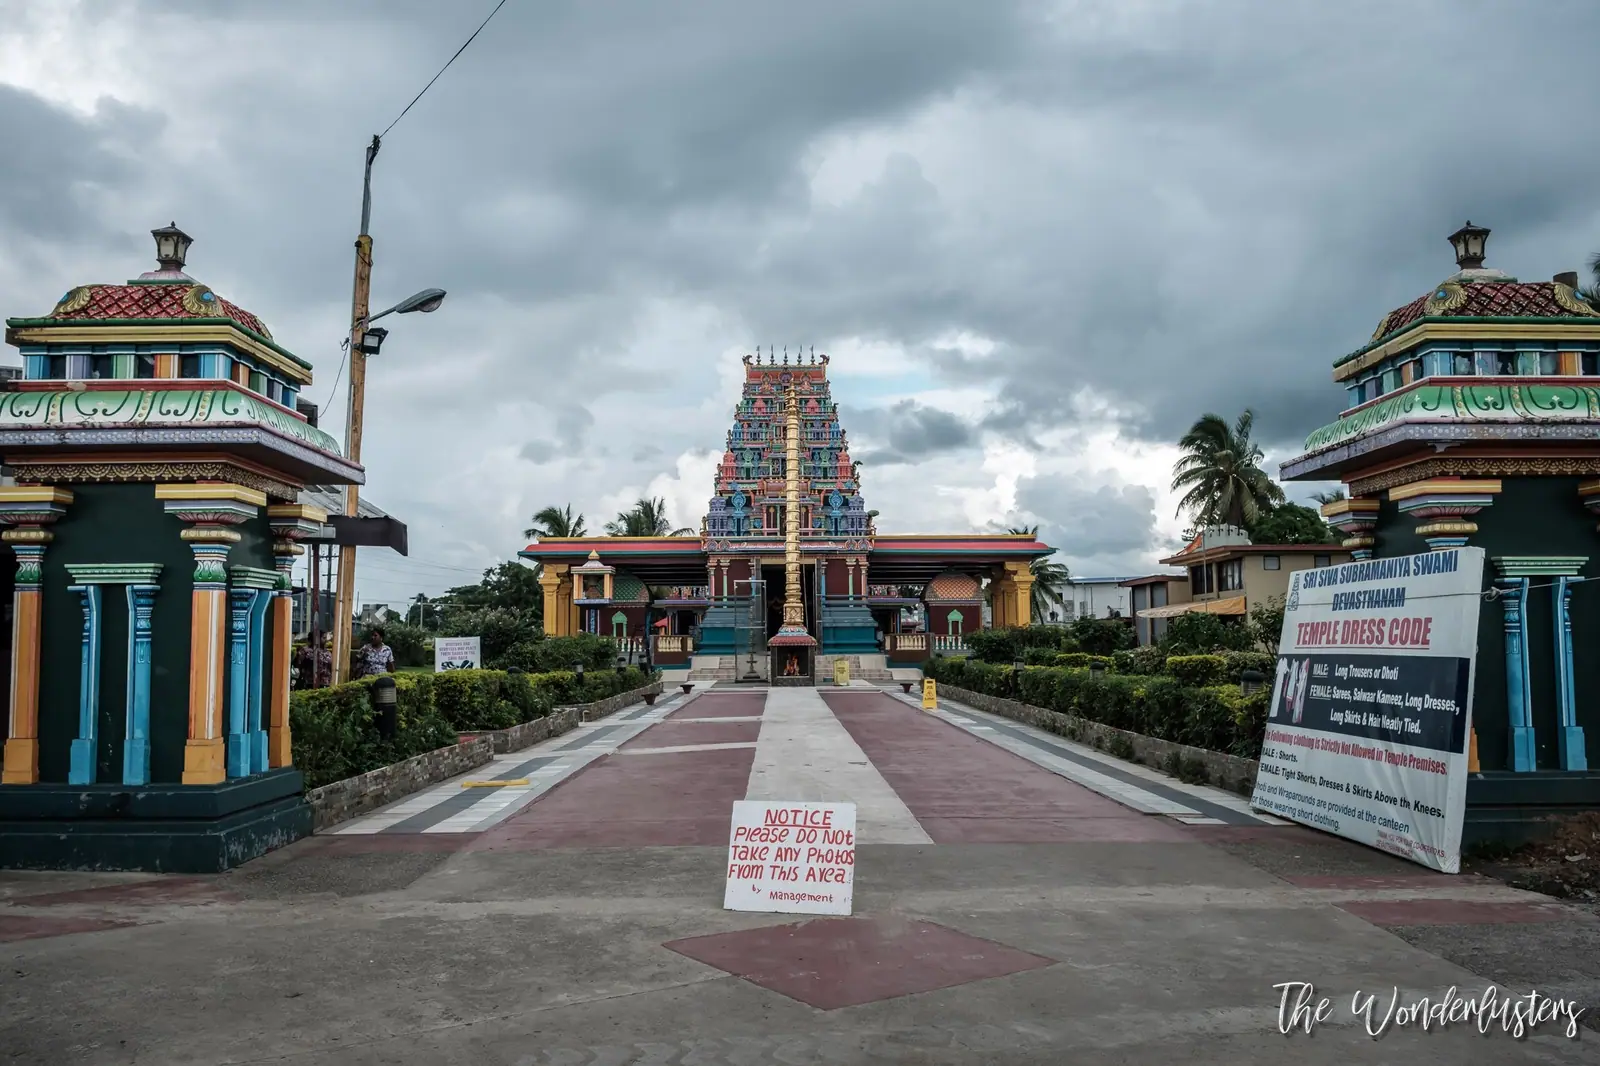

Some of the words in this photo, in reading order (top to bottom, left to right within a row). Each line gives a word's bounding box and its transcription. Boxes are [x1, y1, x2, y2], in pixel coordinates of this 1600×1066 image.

[1303, 571, 1318, 589] SRI
[1318, 567, 1339, 587] SIVA
[1340, 557, 1411, 584] SUBRAMANIYA
[1413, 550, 1459, 576] SWAMI
[1332, 587, 1406, 611] DEVASTHANAM
[1297, 620, 1340, 645] TEMPLE
[1340, 618, 1387, 645] DRESS
[1388, 617, 1433, 646] CODE
[1335, 664, 1348, 680] Long
[1349, 664, 1373, 679] Trousers
[1374, 668, 1381, 679] or
[1381, 666, 1399, 680] Dhoti
[1309, 684, 1333, 699] FEMALE:
[1332, 686, 1352, 703] Sarees,
[1353, 688, 1376, 703] Salwaar
[1376, 690, 1404, 708] Kameez,
[1405, 692, 1422, 711] Long
[1424, 694, 1460, 715] Dresses,
[1330, 708, 1344, 725] Long
[1344, 710, 1361, 725] Skirts
[1362, 712, 1367, 726] &
[1368, 713, 1381, 728] Hair
[1381, 715, 1403, 735] Neatly
[1404, 717, 1421, 734] Tied.
[1320, 737, 1341, 755] Strictly
[1351, 743, 1376, 761] Allowed
[1376, 747, 1383, 762] in
[1384, 749, 1407, 768] Temple
[1408, 754, 1448, 776] Premises.
[1282, 767, 1296, 780] Tight
[1297, 771, 1318, 787] Shorts,
[1319, 776, 1344, 791] Dresses
[1345, 782, 1352, 793] &
[1352, 784, 1373, 800] Skirts
[1374, 790, 1398, 806] Above
[1400, 796, 1411, 810] the
[1413, 800, 1445, 819] Knees.
[764, 809, 834, 826] NOTICE
[1267, 784, 1278, 795] and
[1316, 798, 1327, 809] are
[1327, 801, 1356, 819] provided
[1357, 809, 1364, 821] at
[1365, 810, 1376, 824] the
[1378, 816, 1410, 833] canteen
[1298, 806, 1313, 820] short
[734, 826, 789, 843] Please
[769, 891, 834, 904] Management
